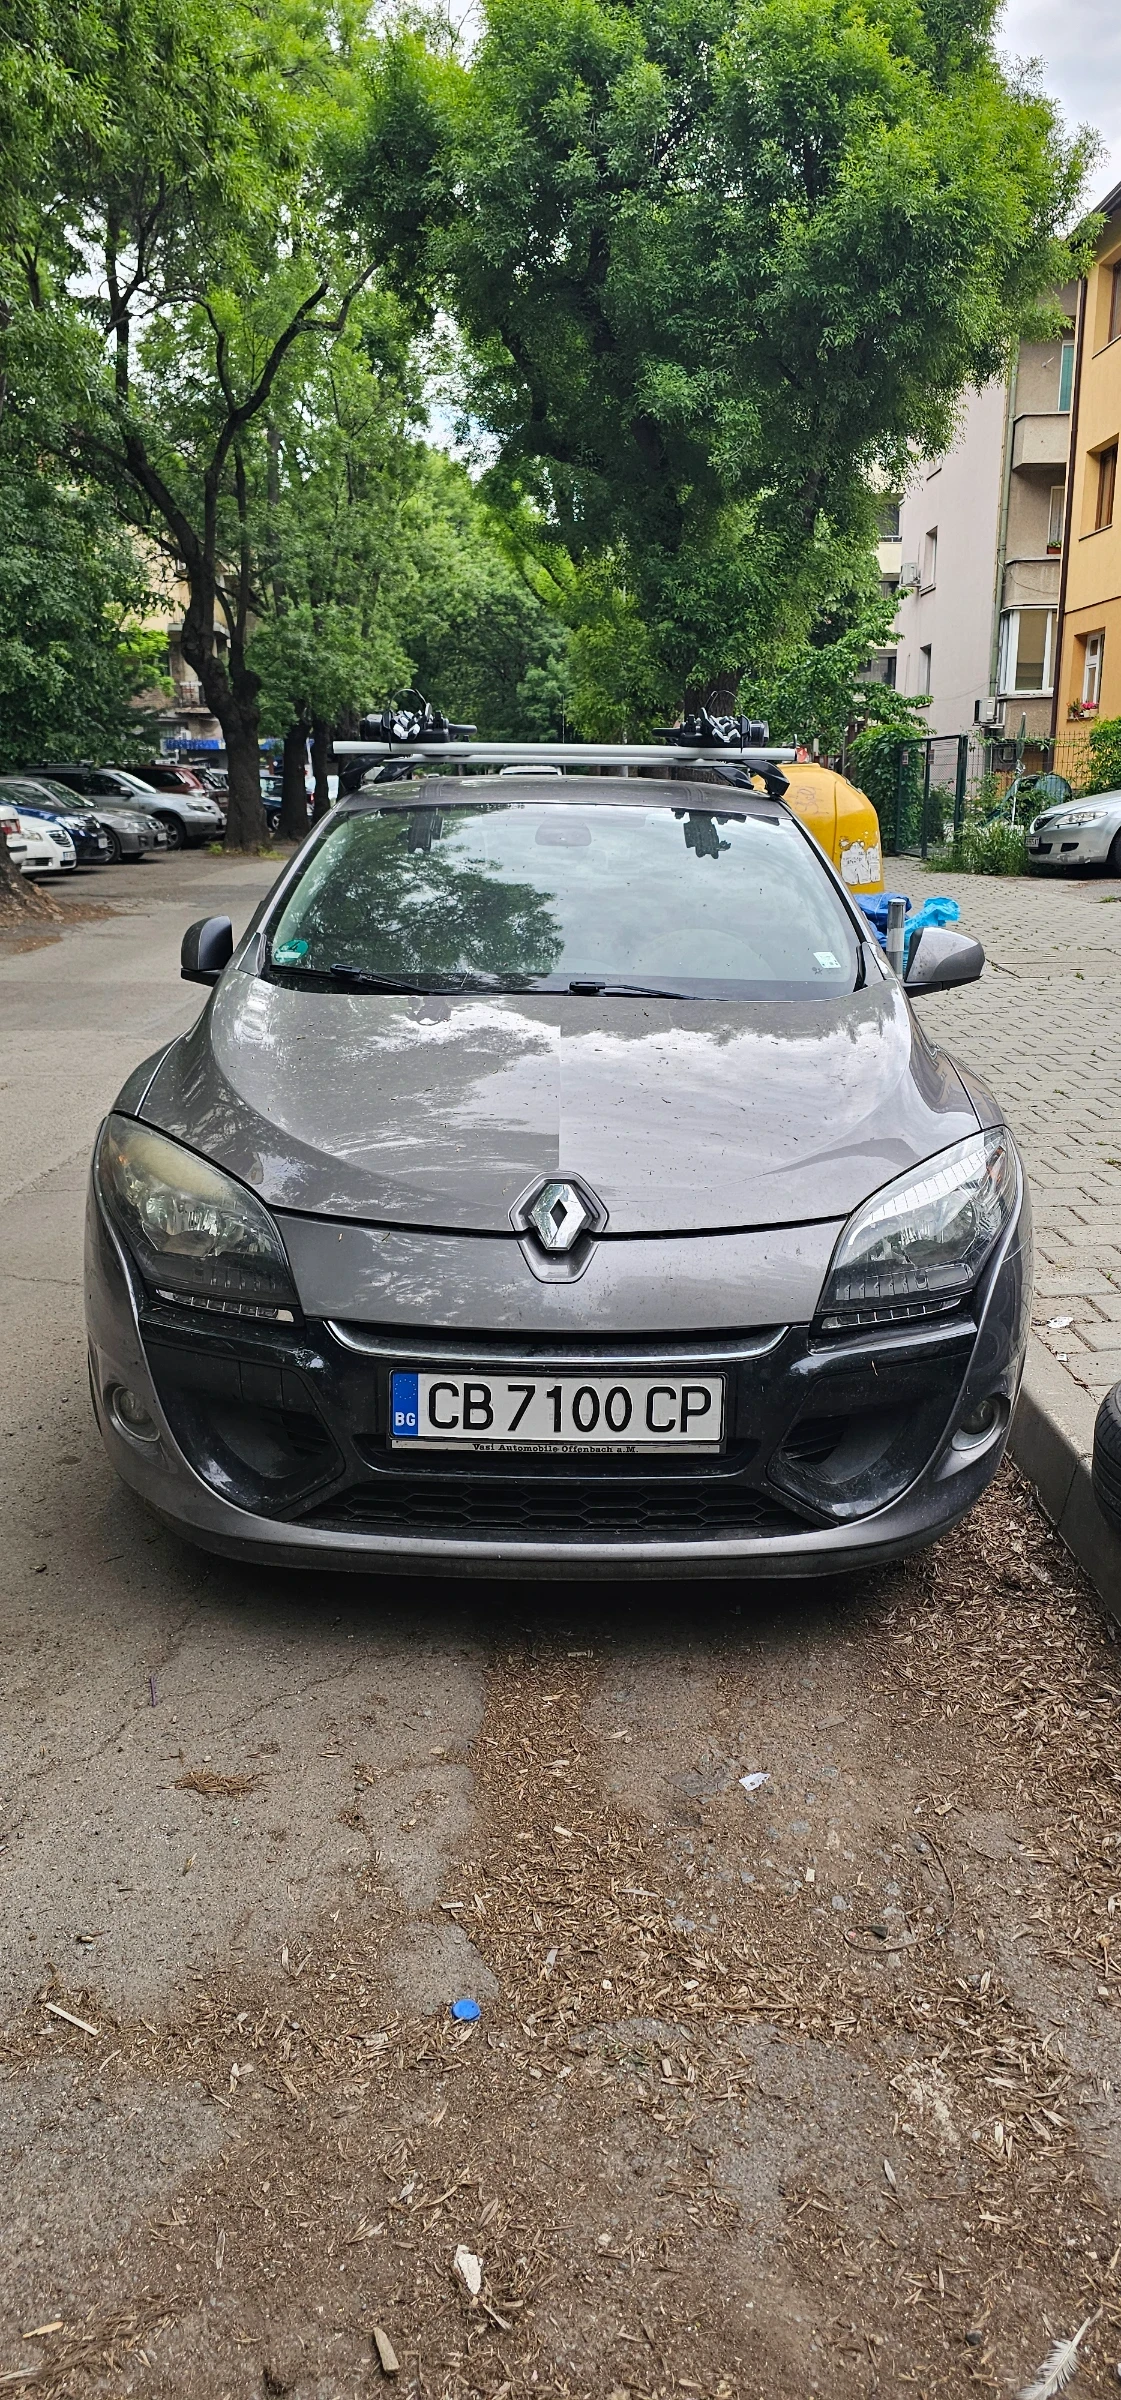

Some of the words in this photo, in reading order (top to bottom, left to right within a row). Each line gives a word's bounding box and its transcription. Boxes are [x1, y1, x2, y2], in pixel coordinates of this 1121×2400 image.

[428, 1382, 494, 1431] CB
[507, 1384, 633, 1433] 7100
[645, 1385, 712, 1434] CP
[395, 1412, 416, 1427] BG
[472, 1442, 495, 1451] Vasi
[498, 1443, 558, 1453] Automobile
[561, 1445, 614, 1453] Offenbach
